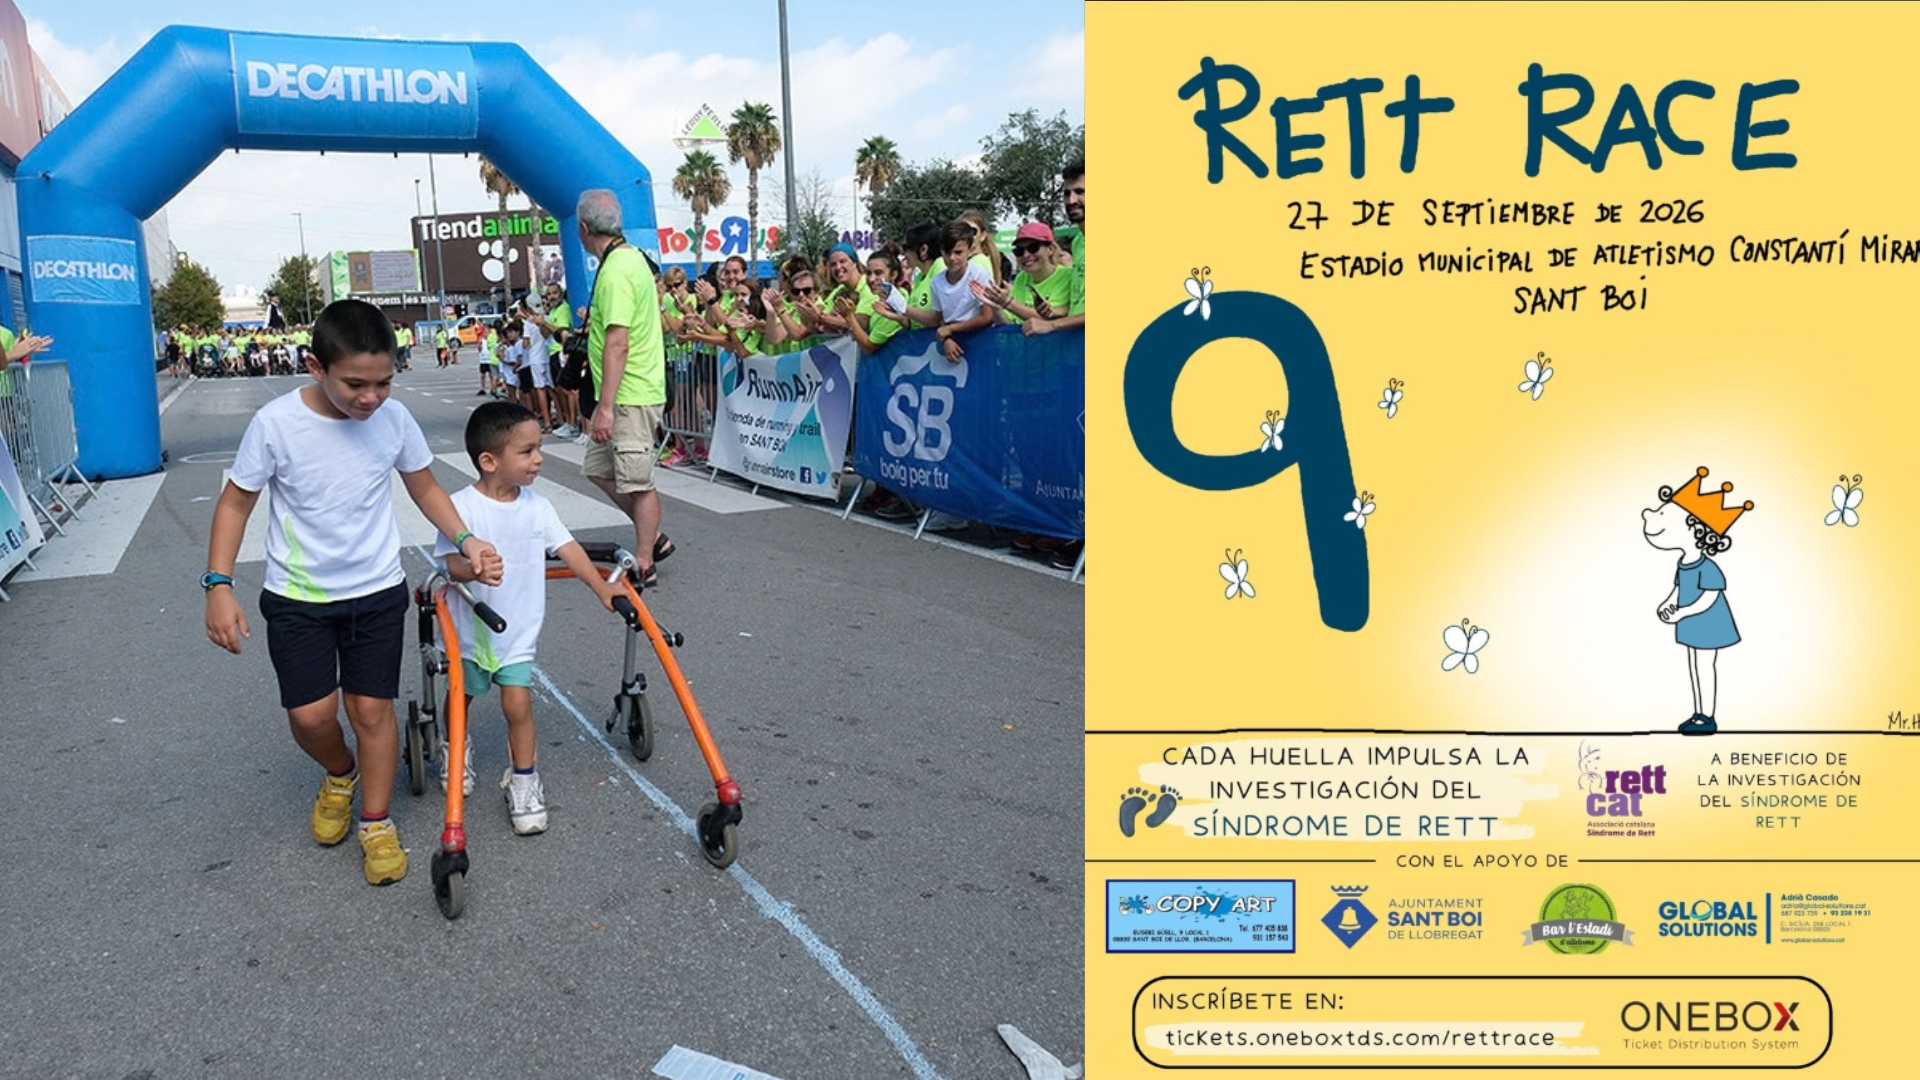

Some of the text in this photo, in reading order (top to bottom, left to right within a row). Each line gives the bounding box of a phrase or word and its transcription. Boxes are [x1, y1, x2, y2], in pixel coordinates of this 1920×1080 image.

[247, 61, 467, 104] DECATHLON
[1517, 62, 1800, 178] RACE
[1287, 200, 1329, 231] 27
[1351, 199, 1396, 227] DE
[1594, 202, 1623, 224] DE
[1639, 199, 1705, 225] 2026
[417, 213, 560, 241] Tiendaima
[1547, 247, 1578, 268] DE
[33, 259, 136, 281] DECATHLON
[1513, 285, 1588, 316] SANT
[747, 367, 823, 404] RunnAir
[799, 420, 822, 437] trail
[882, 382, 955, 462] SB
[880, 458, 949, 490] boig per tu
[1162, 745, 1529, 766] CADA HUELLA IMPULSA LA
[1710, 752, 1848, 766] A BENEFICIO DE
[1210, 775, 1481, 800] INVESTIGACIÓN DEL
[1604, 764, 1667, 795] rett
[1697, 770, 1861, 787] LA INVESTIGACIÓN
[1586, 792, 1643, 817] cat
[1700, 791, 1858, 808] DEL SÍNDROME DE
[1193, 808, 1499, 837] SÍNDROME DE RETT
[1756, 815, 1801, 829] RETT
[1586, 829, 1656, 837] Síndrome de Rett
[1396, 853, 1568, 868] CON EL APOYO DE
[1156, 895, 1277, 913] COPY ART
[1388, 898, 1484, 908] AJUNTAMENT
[1658, 899, 1758, 922] GLOBAL
[1387, 911, 1482, 927] SANT BOI
[1658, 922, 1758, 937] SOLUTIONS
[1388, 930, 1483, 939] DE LLOBREGAT
[1542, 923, 1566, 937] Bar
[1152, 986, 1344, 1010] INSCRÍBETE EN:
[1620, 1000, 1800, 1033] ONEBOX
[1623, 1038, 1800, 1052] Ticket Distribution System
